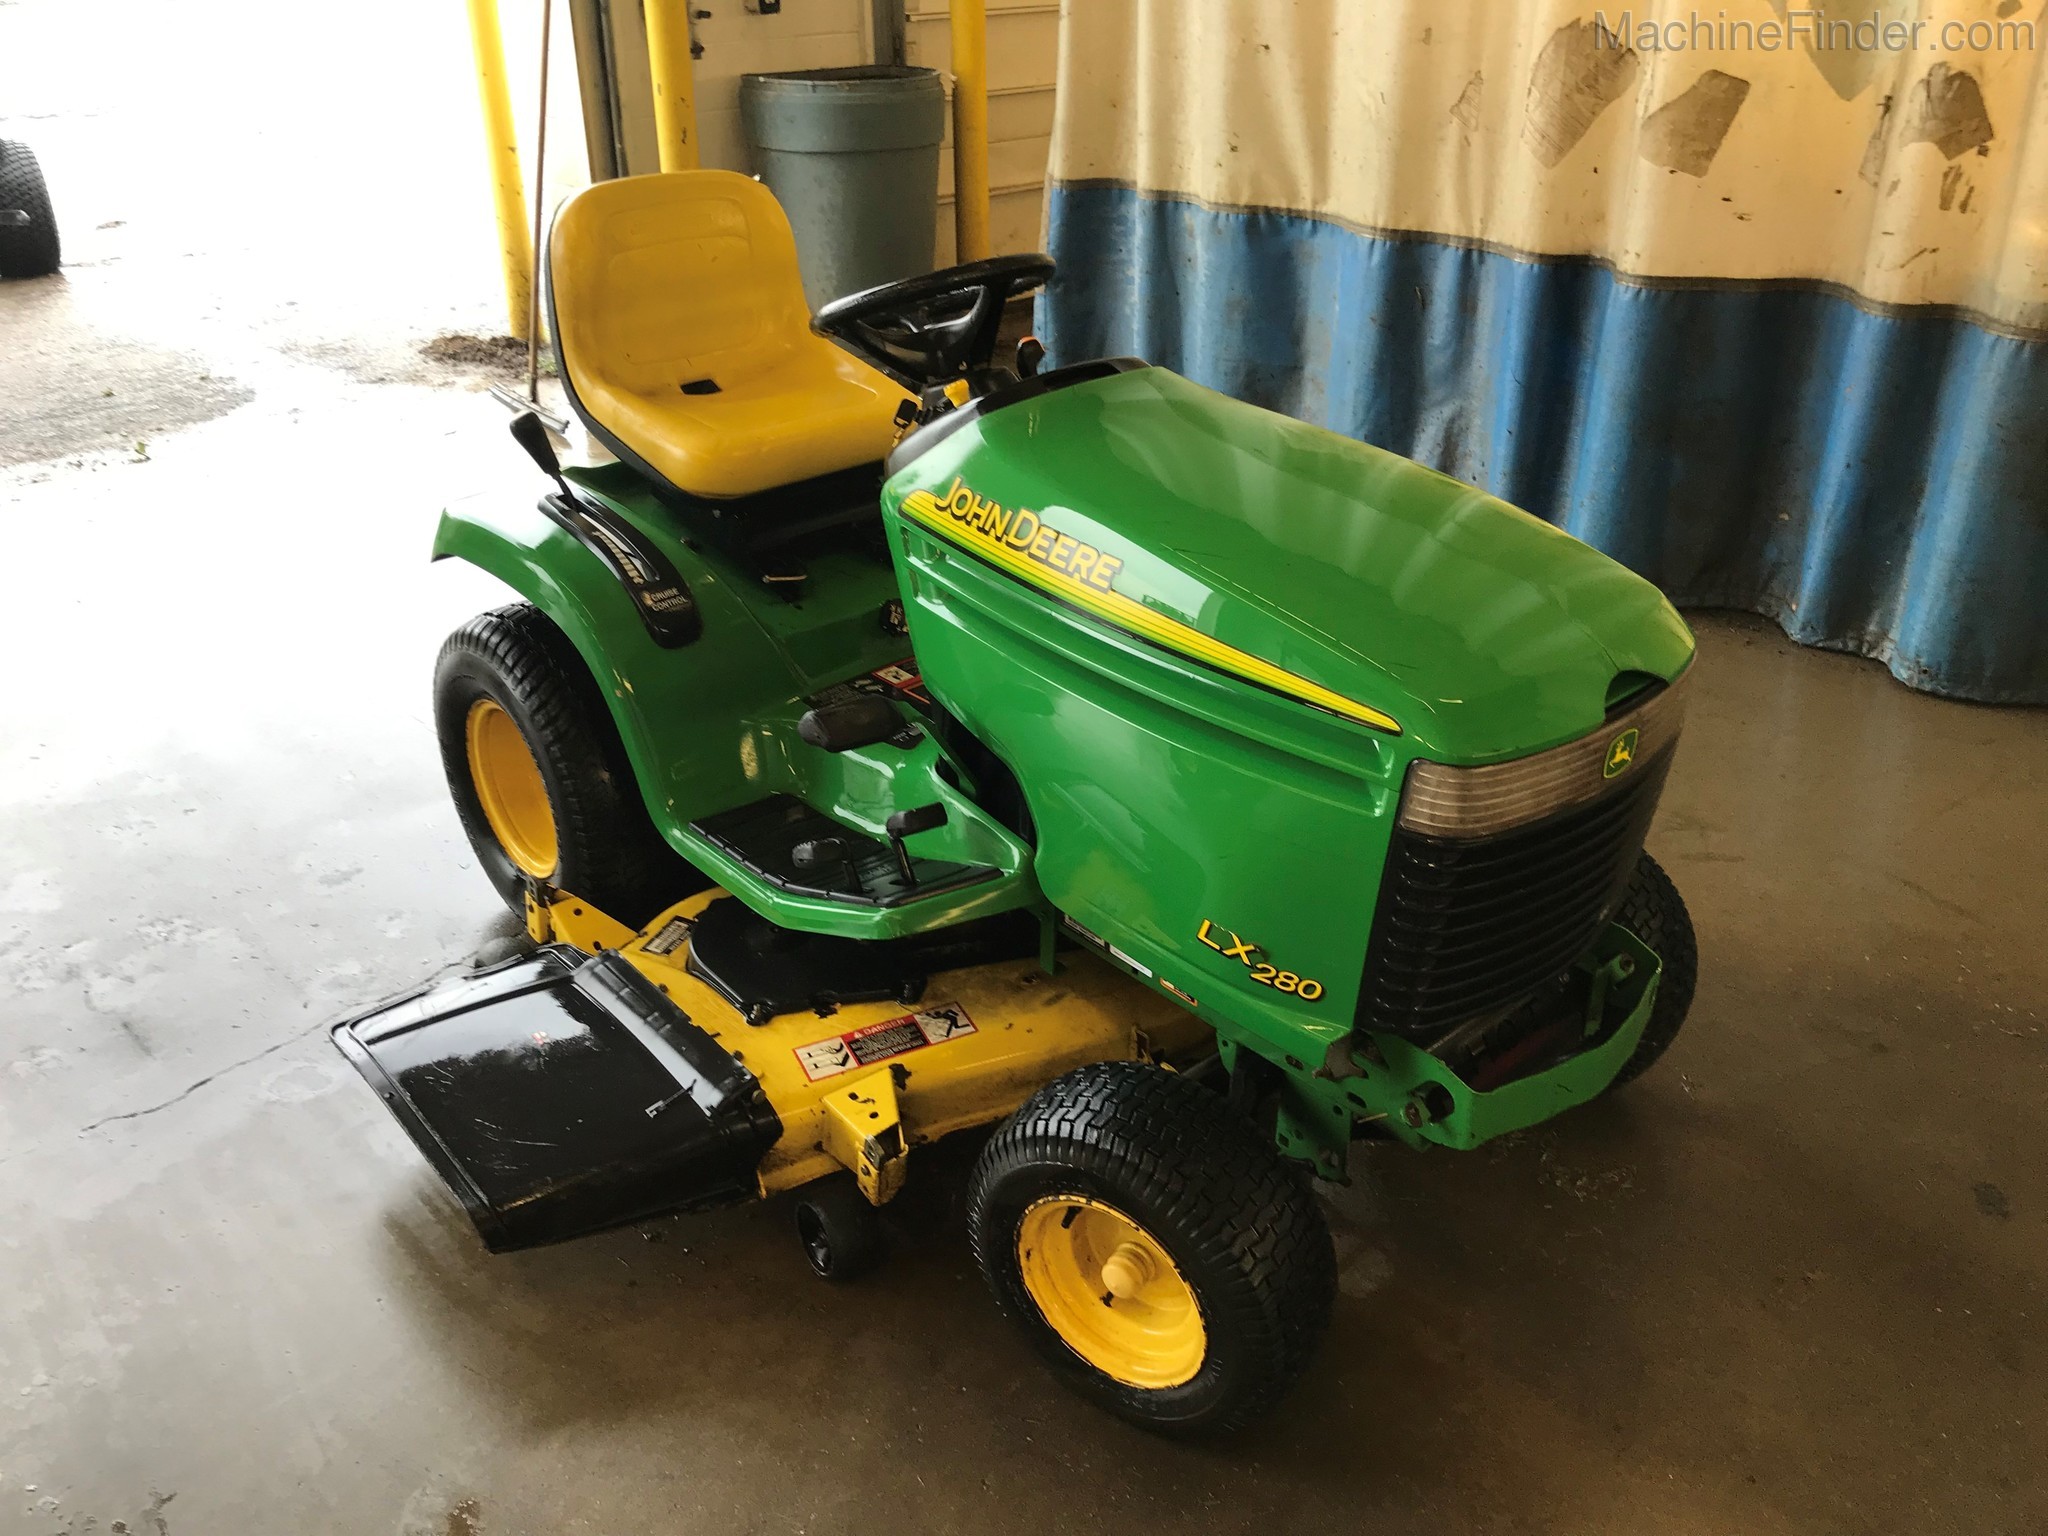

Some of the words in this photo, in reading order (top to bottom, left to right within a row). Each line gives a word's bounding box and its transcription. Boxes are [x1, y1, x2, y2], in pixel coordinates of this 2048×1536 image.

[934, 477, 1013, 541] JOHN
[1006, 509, 1123, 593] DEERE
[650, 587, 679, 602] CRUISE
[651, 594, 688, 611] CONTROL
[863, 1019, 905, 1035] DANGER
